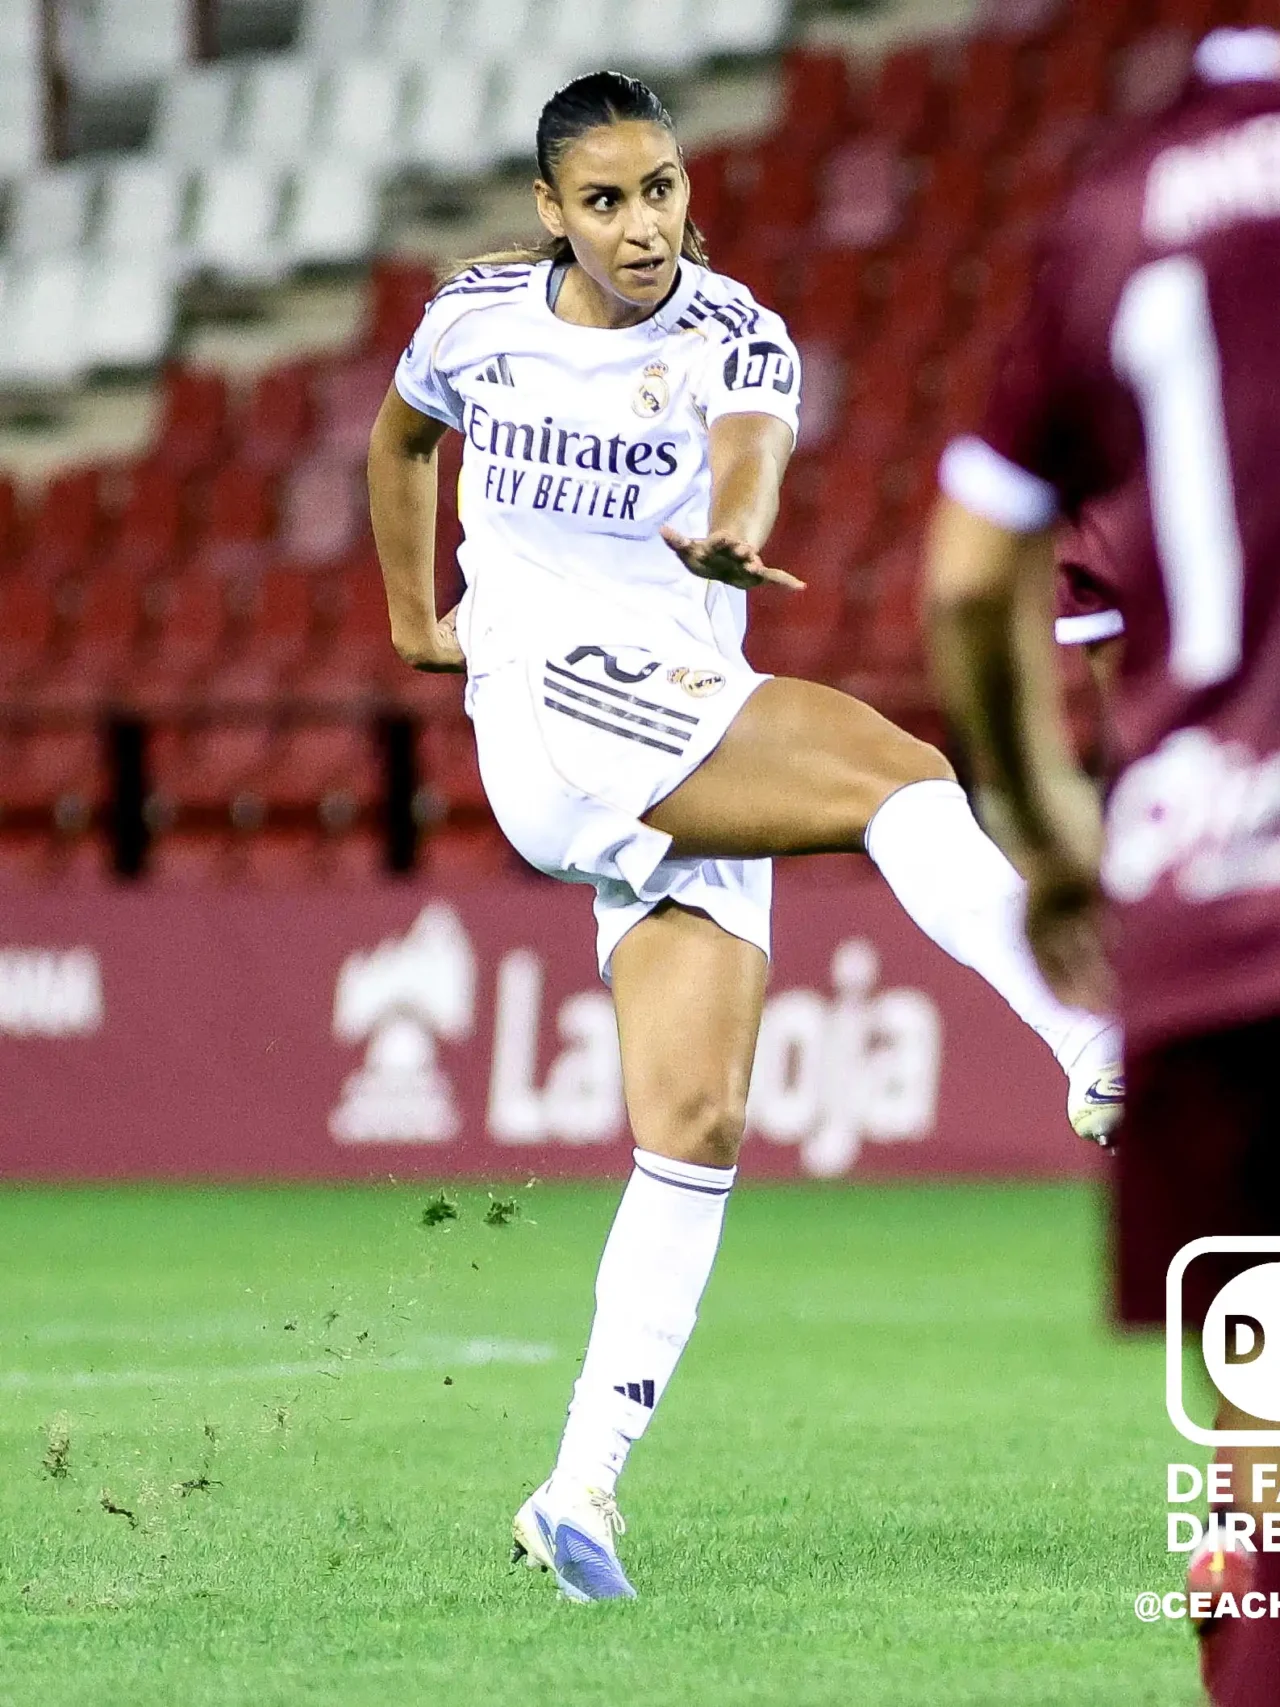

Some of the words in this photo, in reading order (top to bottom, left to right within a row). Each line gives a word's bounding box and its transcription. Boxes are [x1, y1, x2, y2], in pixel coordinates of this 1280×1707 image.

[724, 341, 794, 395] hp
[469, 403, 677, 477] Emirates
[485, 465, 525, 507] FLY
[533, 473, 640, 521] BETTER
[746, 938, 941, 1178] oja
